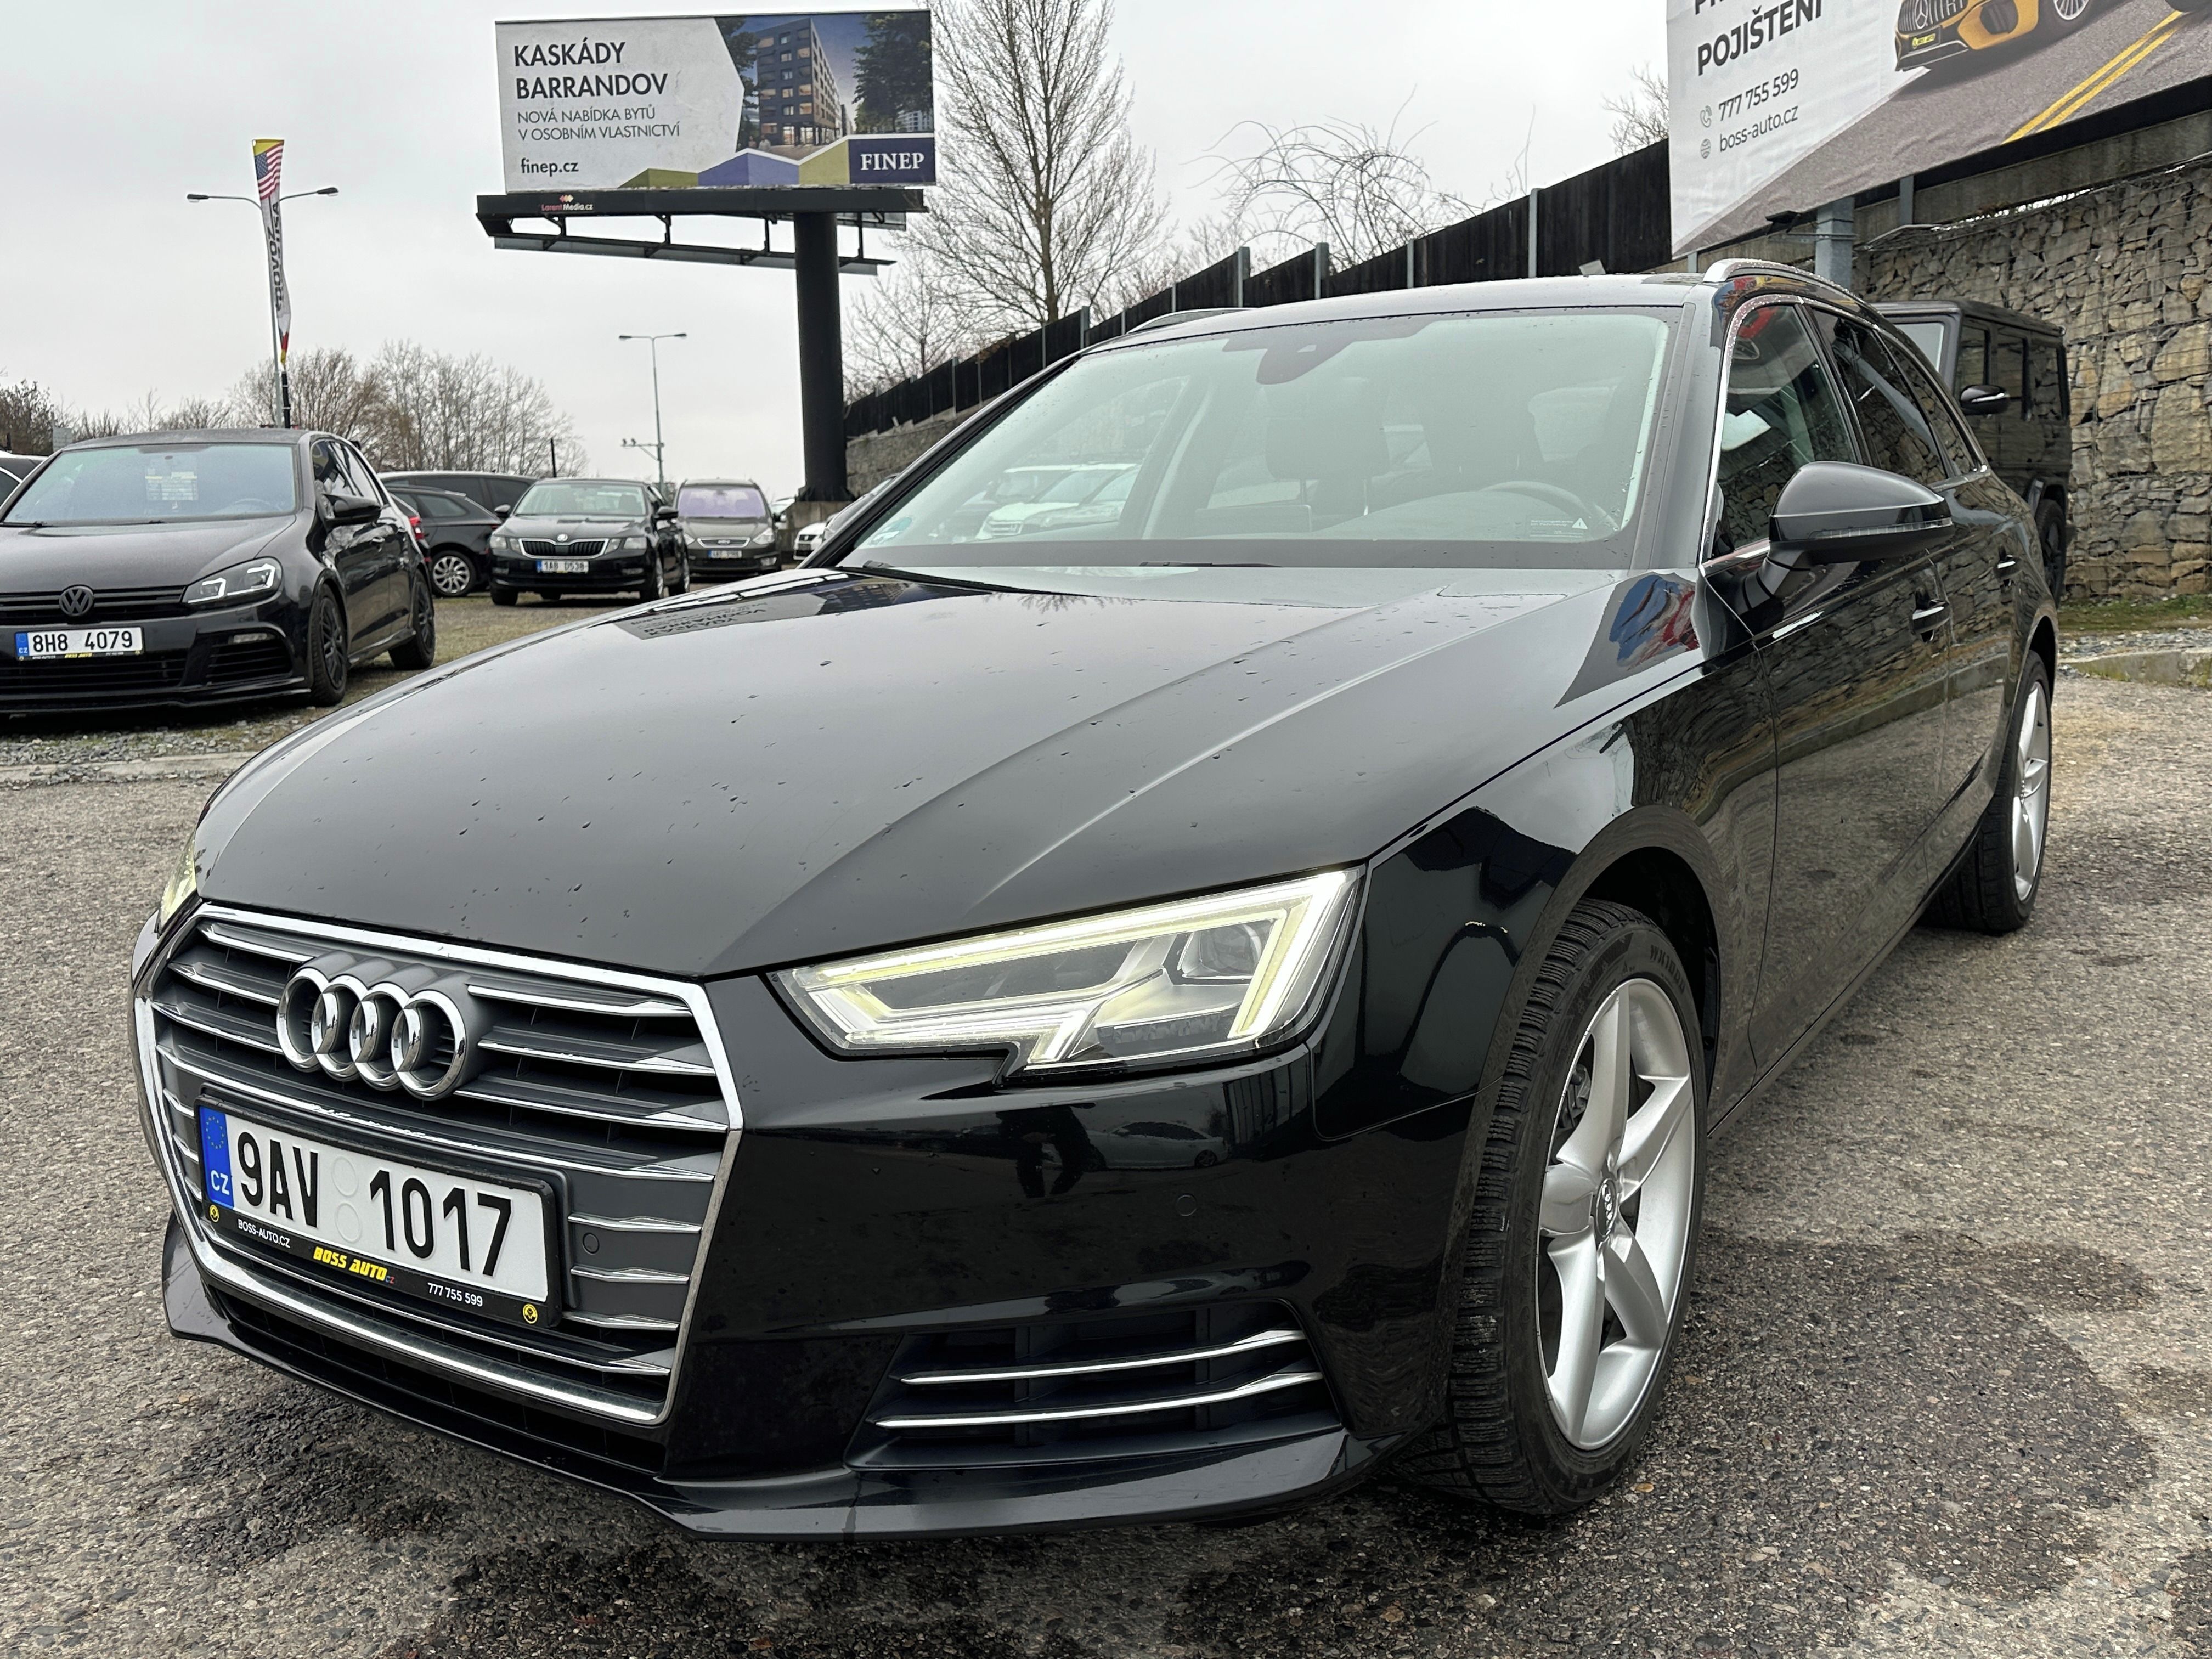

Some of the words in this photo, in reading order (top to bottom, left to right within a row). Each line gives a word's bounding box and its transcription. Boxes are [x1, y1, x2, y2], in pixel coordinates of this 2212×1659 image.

[514, 36, 626, 67] KASKÁDY
[516, 72, 668, 99] BARRANDOV
[1718, 94, 1743, 122] 777
[1745, 81, 1769, 110] 755
[1772, 68, 1799, 98] 599
[517, 107, 558, 124] NOVÁ
[561, 105, 622, 122] NABÍDKA
[624, 103, 656, 120] BYTŮ
[518, 128, 528, 141] V
[531, 124, 597, 141] OSOBNÍM
[599, 121, 681, 138] VLASTNICTVÍ
[1719, 105, 1799, 153] boss-auto.cz
[521, 157, 579, 177] finep.cz
[860, 152, 925, 171] FINEP
[32, 634, 69, 653] 8H8
[84, 630, 133, 651] 4079
[210, 1170, 230, 1195] CZ
[238, 1131, 319, 1228] 9AV
[370, 1169, 512, 1277] 1017
[238, 1218, 291, 1249] BOSS-AUTO.CZ
[313, 1246, 347, 1269] BOSS
[348, 1258, 387, 1282] AUTO
[427, 1282, 443, 1296] 777
[444, 1287, 463, 1302] 755
[464, 1292, 483, 1307] 599
